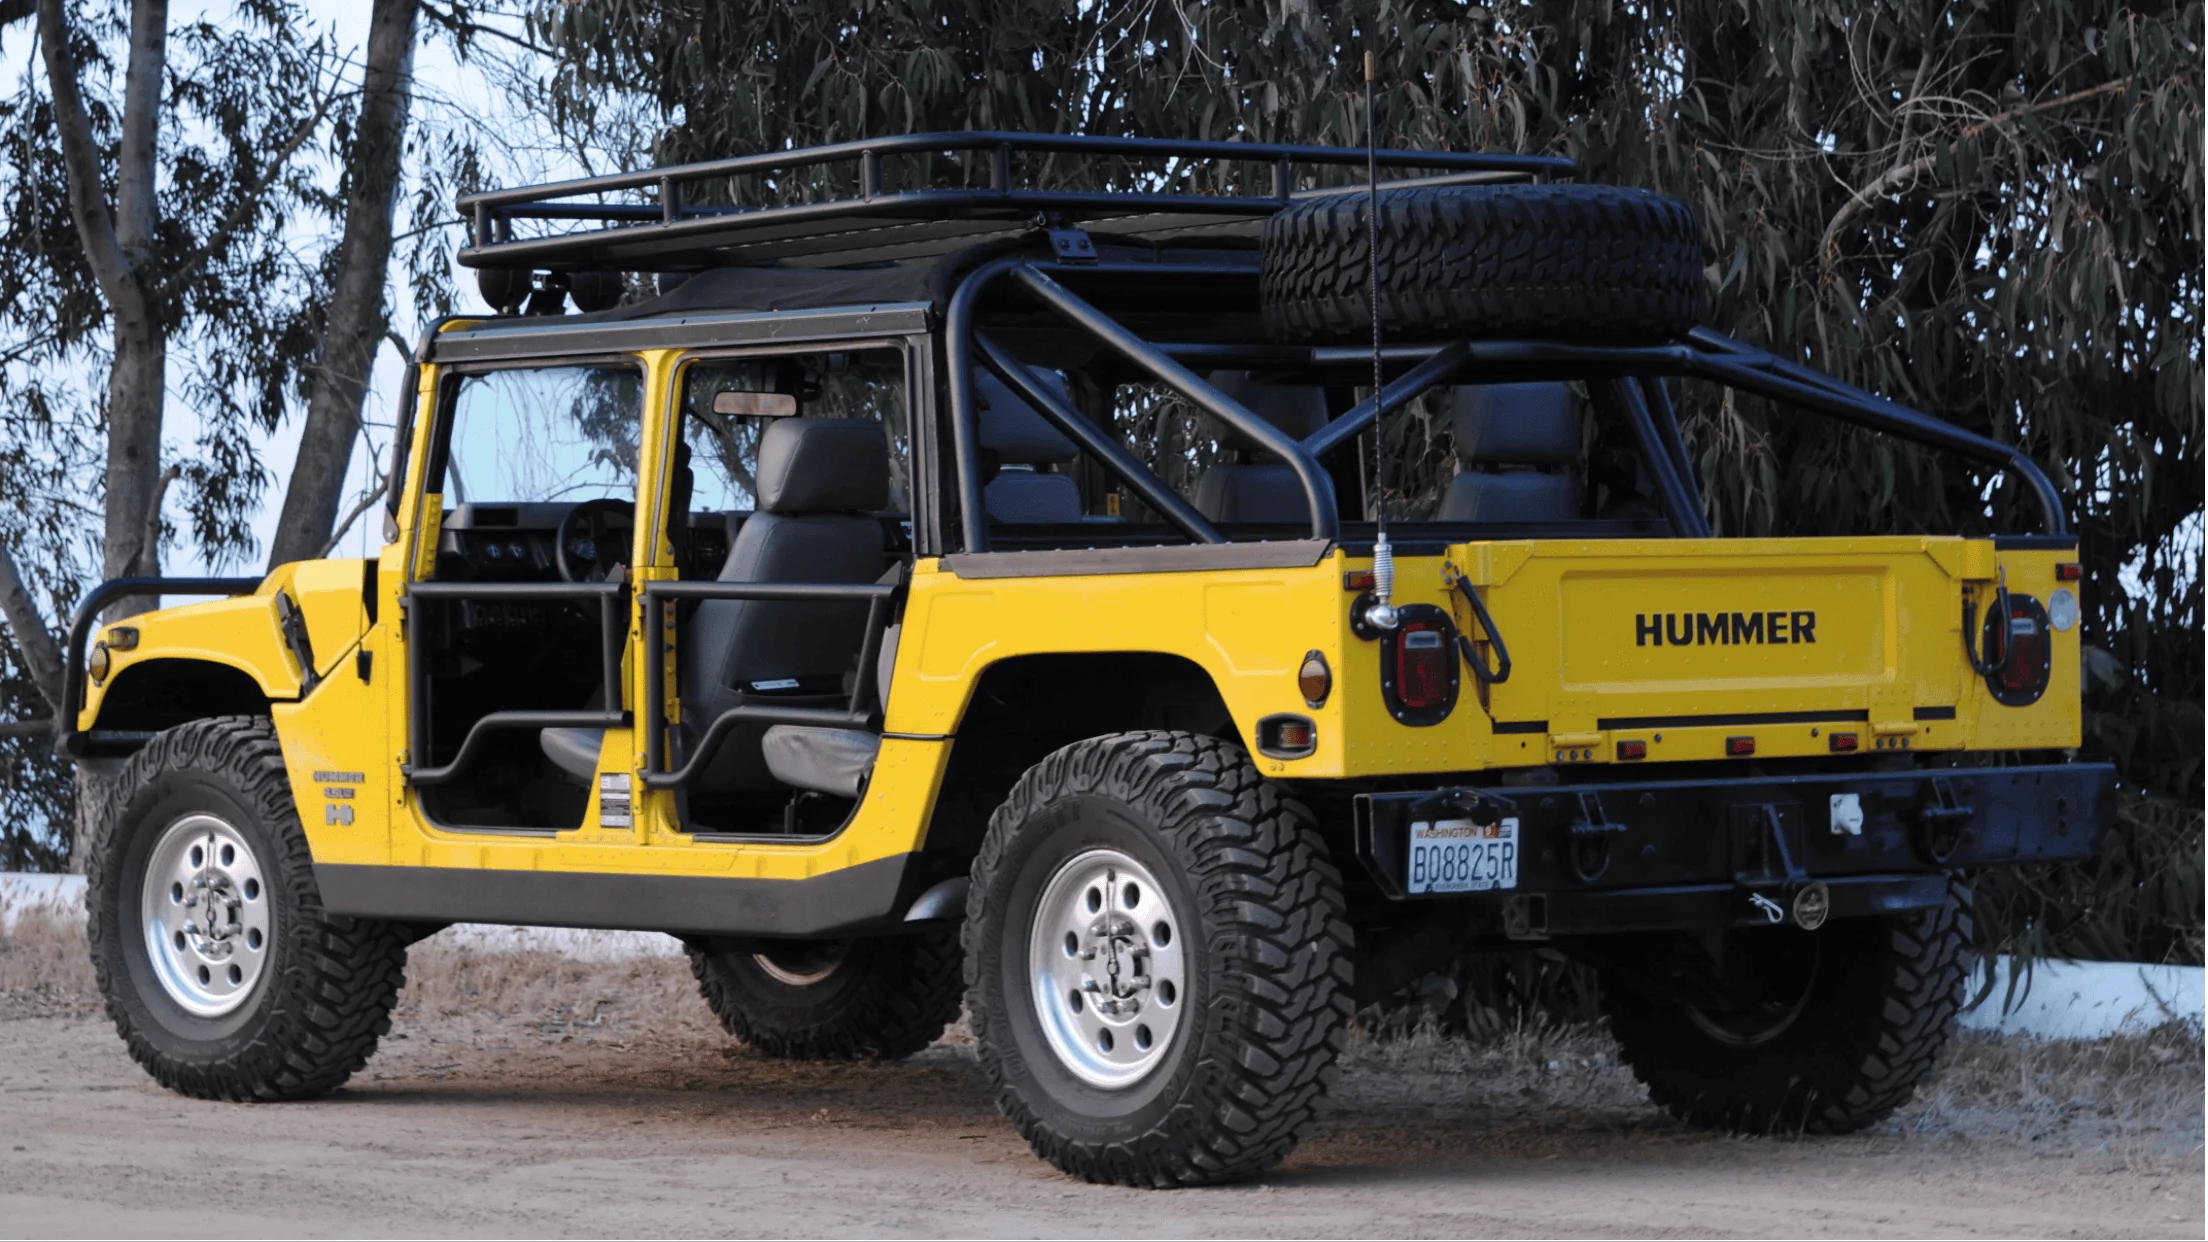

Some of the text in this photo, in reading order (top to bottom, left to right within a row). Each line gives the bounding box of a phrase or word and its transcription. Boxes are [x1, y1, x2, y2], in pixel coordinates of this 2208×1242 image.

[1635, 611, 1816, 647] HUMMER
[1416, 827, 1478, 839] WASHINGTON
[1414, 842, 1514, 884] B08825R
